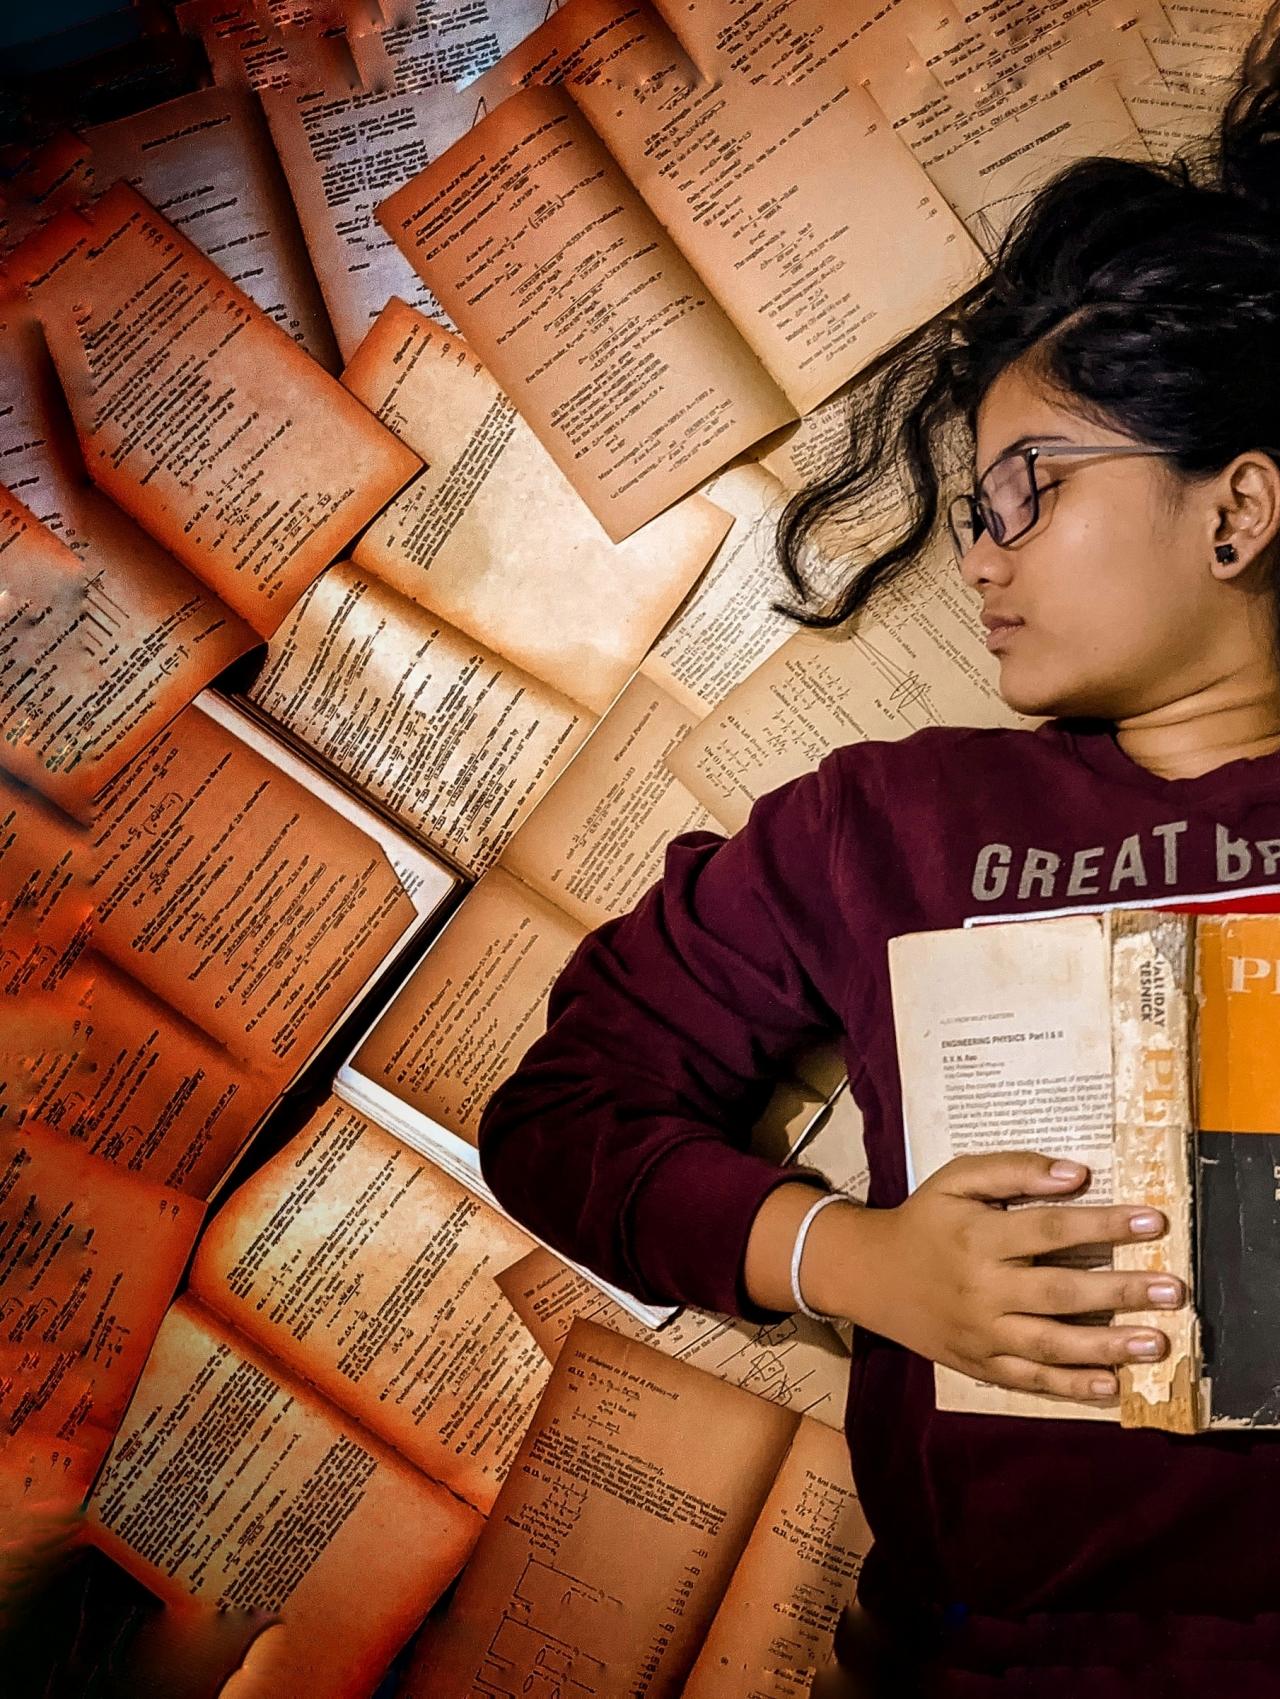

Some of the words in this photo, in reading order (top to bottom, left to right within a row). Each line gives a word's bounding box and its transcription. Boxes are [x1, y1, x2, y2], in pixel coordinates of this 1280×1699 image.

[970, 820, 1188, 901] GREAT
[941, 1036, 990, 1048] ENGINEERING
[992, 1033, 1025, 1043] PHYSICS
[1028, 1032, 1043, 1040] Part
